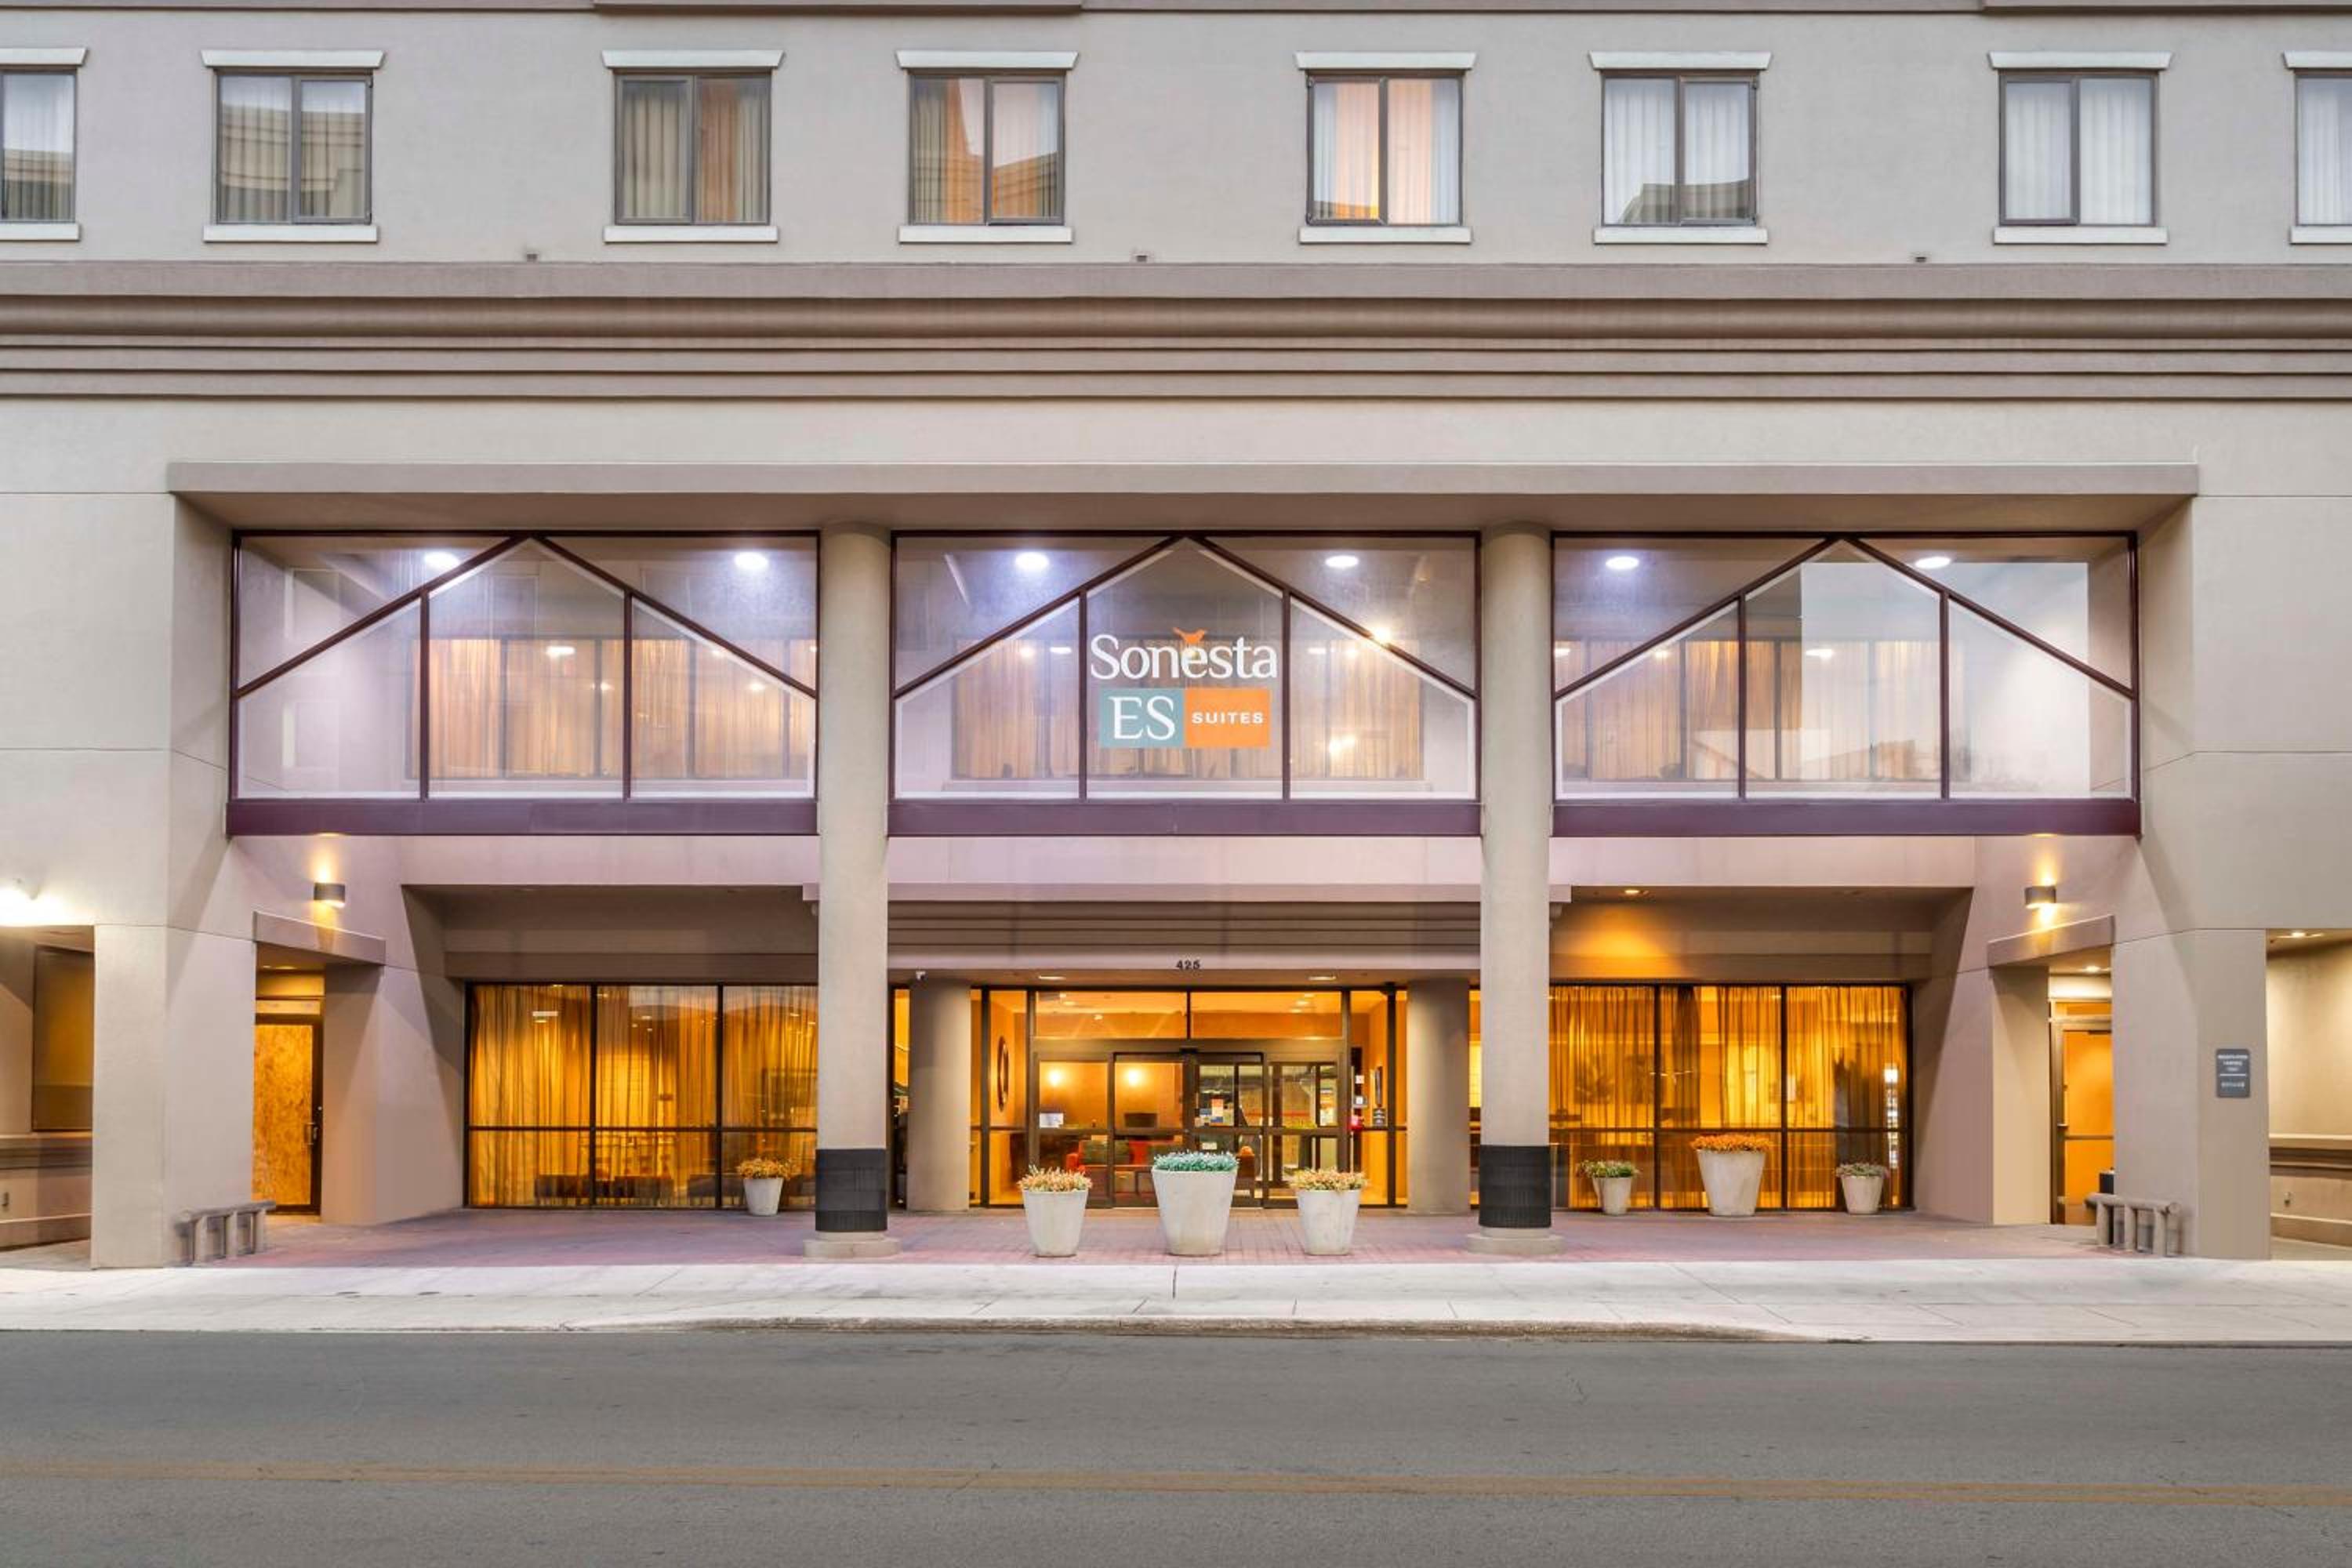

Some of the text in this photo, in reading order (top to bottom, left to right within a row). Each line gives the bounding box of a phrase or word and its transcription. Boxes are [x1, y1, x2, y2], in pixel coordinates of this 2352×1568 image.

[1091, 634, 1277, 680] Sonesta
[1109, 696, 1263, 741] ES SUITES
